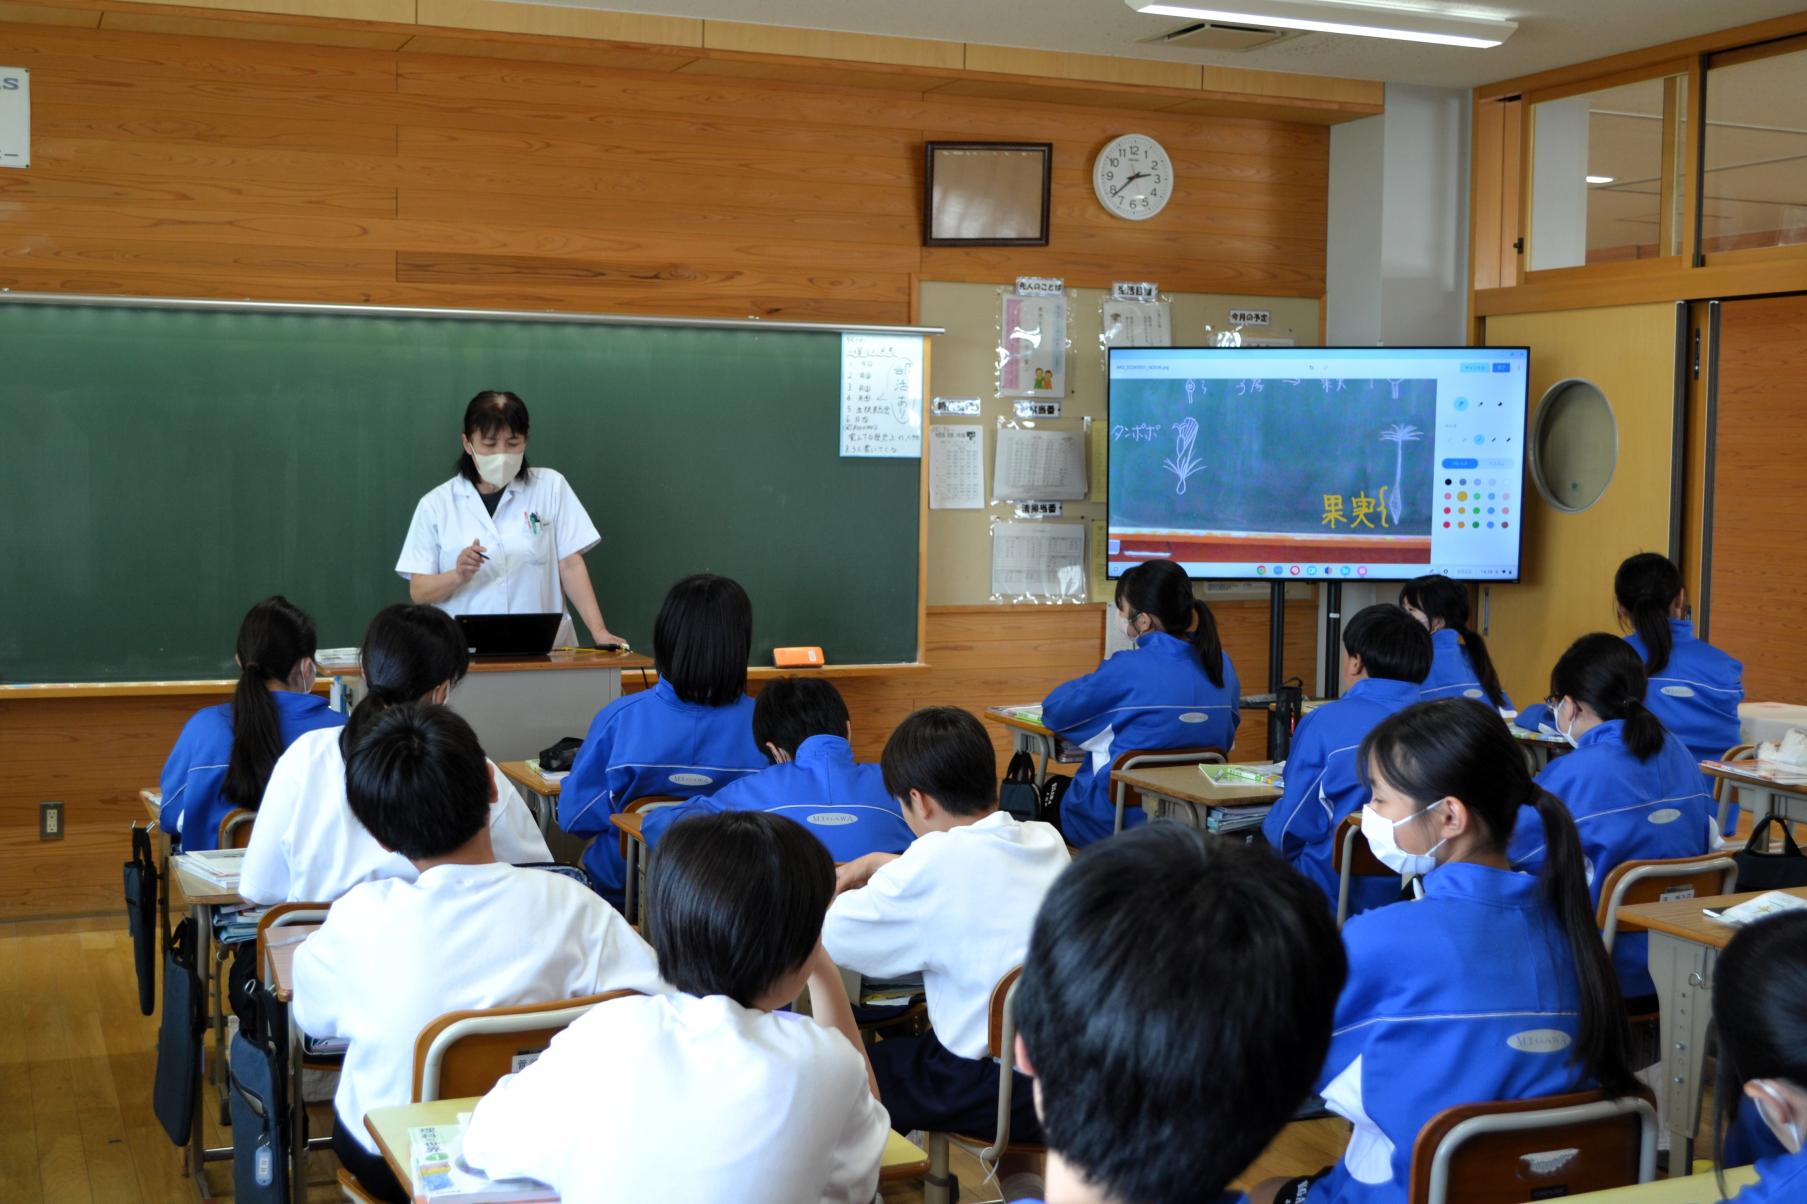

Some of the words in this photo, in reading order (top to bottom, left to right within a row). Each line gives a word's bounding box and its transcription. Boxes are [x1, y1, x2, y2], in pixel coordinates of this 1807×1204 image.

[0, 77, 19, 90] S
[1118, 148, 1126, 158] 11
[1129, 145, 1140, 156] 12
[1144, 150, 1148, 159] 1
[1109, 158, 1120, 168] 10
[1151, 160, 1158, 170] 2
[1106, 171, 1114, 181] 9
[1154, 174, 1161, 184] 3
[1109, 184, 1117, 195] 8
[1150, 187, 1157, 197] 4
[1118, 195, 1125, 205] 7
[1129, 200, 1137, 209] 6
[1141, 197, 1149, 207] 5
[1231, 311, 1268, 323] 今月の予定
[1111, 423, 1162, 442] タンポポ
[1321, 490, 1376, 529] 果実
